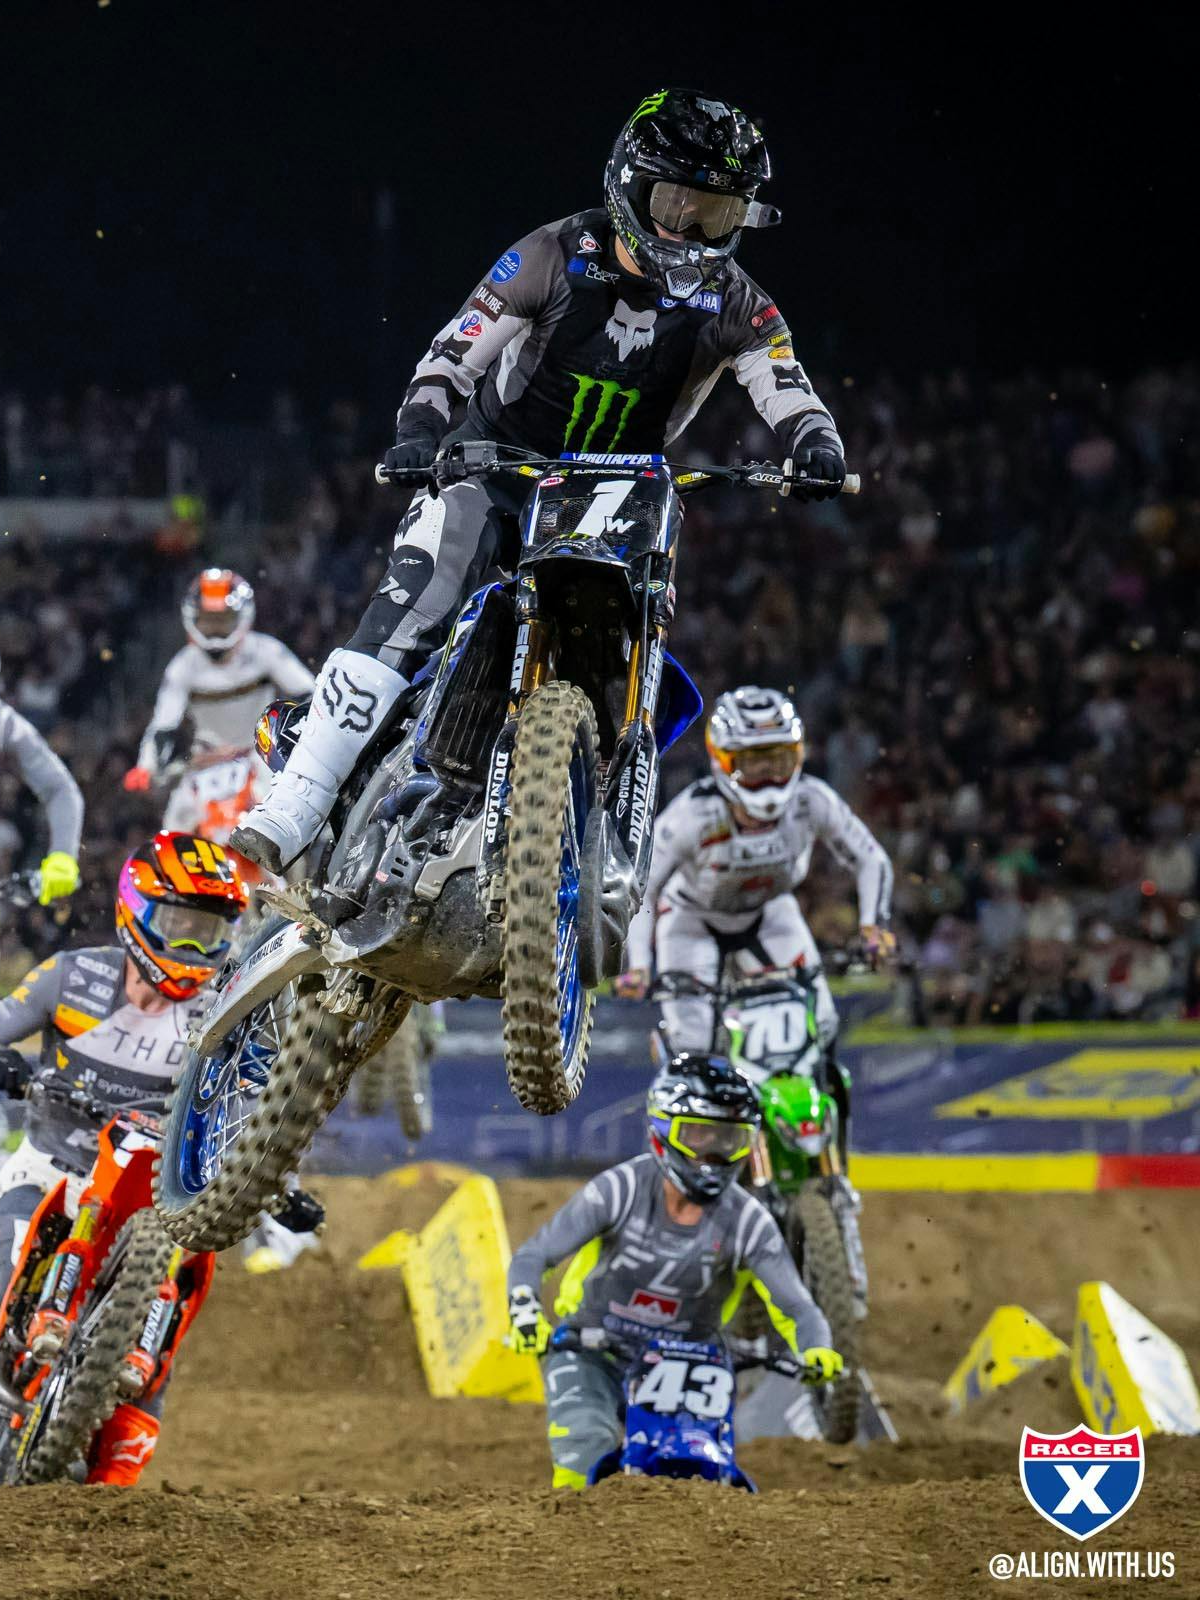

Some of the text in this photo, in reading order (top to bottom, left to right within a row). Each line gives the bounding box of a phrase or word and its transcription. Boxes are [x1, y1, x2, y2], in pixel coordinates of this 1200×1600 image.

[475, 286, 503, 315] ALUBE
[686, 292, 718, 310] MAHA
[576, 453, 651, 465] PROTAPER
[748, 473, 784, 483] ARC
[574, 480, 637, 537] 1
[486, 751, 509, 844] DUNLOP
[629, 751, 650, 846] DUNLOP
[113, 1026, 188, 1066] THO
[744, 1003, 808, 1060] 70
[140, 1298, 165, 1351] DUNLO
[634, 1359, 734, 1419] 43
